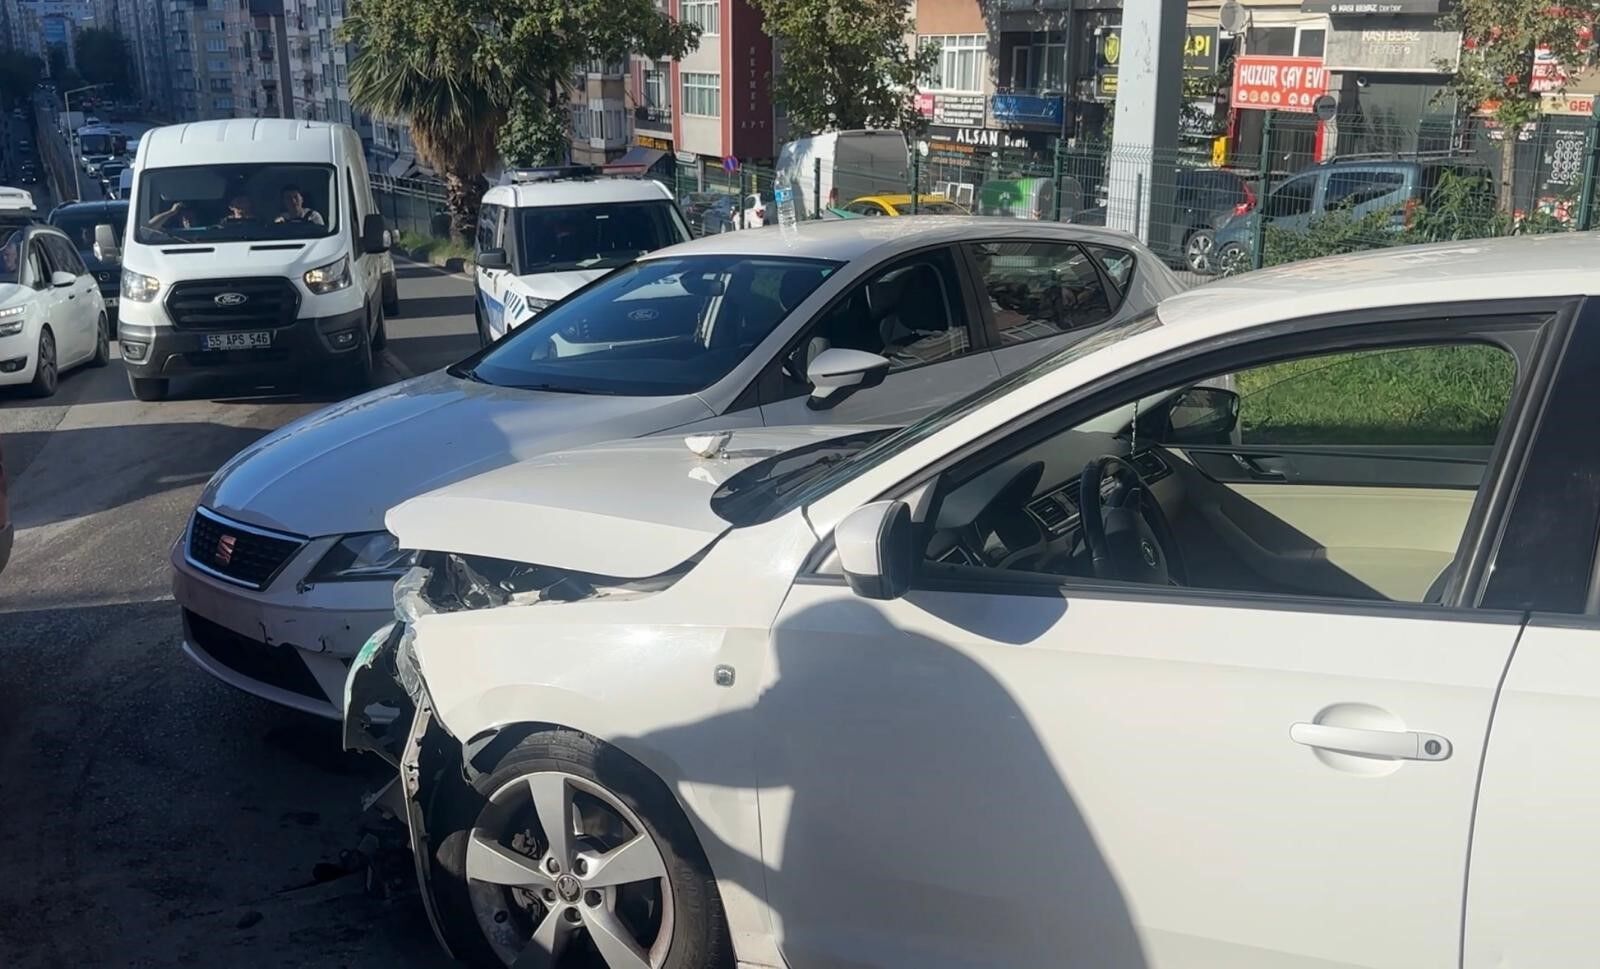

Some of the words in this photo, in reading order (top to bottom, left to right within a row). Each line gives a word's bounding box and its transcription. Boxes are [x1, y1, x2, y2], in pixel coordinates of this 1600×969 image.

[1240, 64, 1278, 88] HUZUR
[1281, 66, 1303, 92] ÇAY
[956, 128, 998, 146] ALSAN
[208, 335, 221, 347] 55
[226, 334, 245, 345] APS
[249, 332, 269, 344] 546
